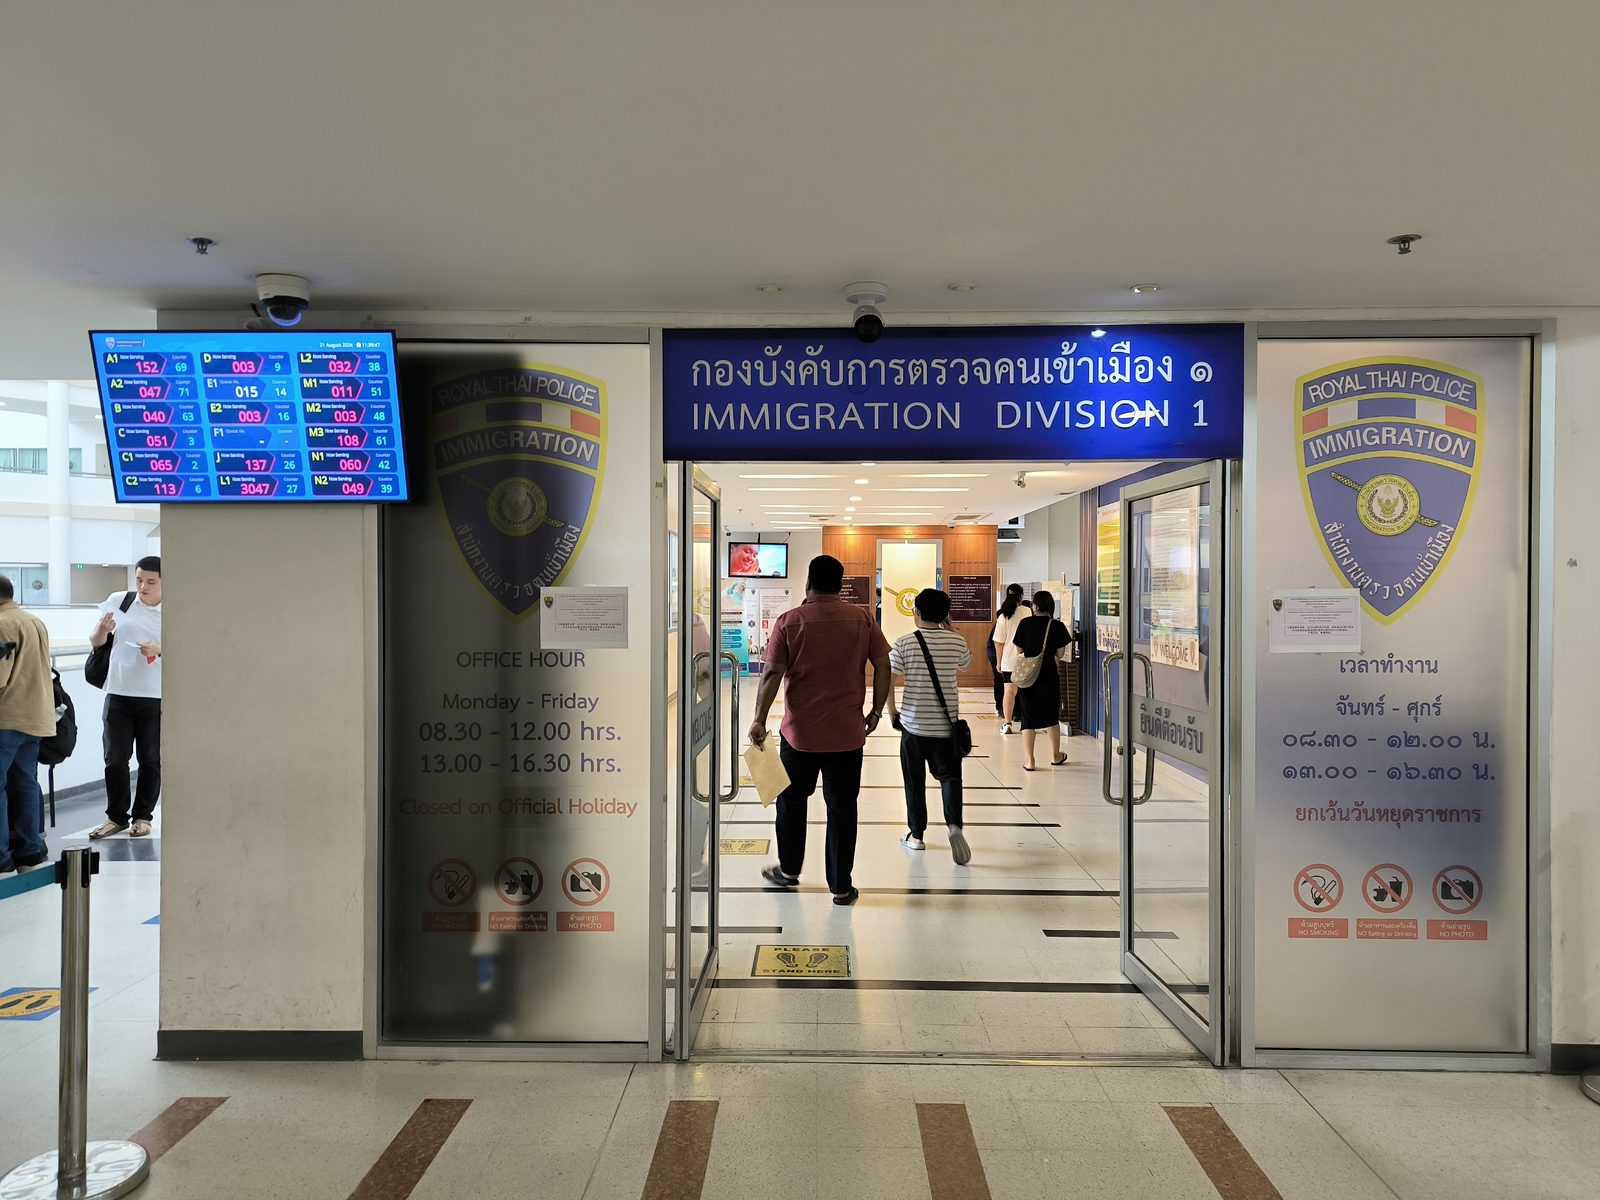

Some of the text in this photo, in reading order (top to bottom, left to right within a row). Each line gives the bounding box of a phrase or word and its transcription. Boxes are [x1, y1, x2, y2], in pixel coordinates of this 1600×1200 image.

[106, 354, 118, 363] A1
[204, 354, 211, 363] D
[300, 354, 312, 362] L2
[136, 362, 158, 373] 152
[175, 363, 187, 372] 69
[232, 361, 255, 373] 003
[275, 363, 280, 371] 9
[329, 361, 352, 373] 032
[369, 363, 380, 371] 38
[691, 340, 1173, 387] กองบังคับการตรวจคนเข้าเมือง
[111, 380, 123, 388] A2
[207, 379, 217, 388] E1
[304, 379, 317, 388] M1
[1308, 371, 1473, 403] ROYAL THAI POLICE
[139, 387, 161, 398] 047
[178, 388, 189, 396] 71
[235, 386, 258, 398] 015
[275, 388, 286, 396] 14
[332, 386, 352, 397] 011
[371, 388, 382, 396] 51
[439, 376, 597, 407] ROYAL THAI POLICE
[114, 405, 121, 413] B
[210, 404, 222, 413] E2
[306, 403, 321, 412] M2
[143, 411, 165, 422] 040
[182, 413, 194, 421] 63
[239, 411, 261, 422] 003
[278, 413, 290, 421] 16
[334, 411, 356, 422] 003
[374, 412, 385, 420] 48
[692, 399, 1209, 430] IMMIGRATION DIVISION 1
[118, 428, 125, 437] C
[214, 428, 224, 437] F1
[309, 428, 324, 437] M3
[147, 436, 168, 446] 051
[189, 437, 194, 445] 3
[337, 436, 359, 446] 108
[376, 437, 386, 445] 61
[439, 430, 595, 462] IMMIGRATION
[1309, 427, 1471, 459] IMMIGRATION
[122, 453, 133, 461] C1
[217, 452, 220, 463] J
[312, 452, 324, 461] N1
[151, 460, 172, 471] 065
[192, 462, 198, 470] 2
[246, 460, 266, 470] 137
[284, 461, 295, 469] 26
[340, 460, 362, 470] 060
[379, 461, 390, 469] 42
[126, 477, 138, 485] C2
[220, 476, 230, 485] L1
[315, 476, 328, 485] N2
[154, 484, 176, 494] 113
[196, 485, 201, 493] 6
[241, 484, 270, 494] 3047
[287, 485, 298, 493] 27
[342, 483, 364, 494] 049
[381, 485, 392, 493] 39
[1362, 513, 1415, 533] IMMIGRATION BUREAU
[1159, 644, 1189, 662] WELCOME
[456, 652, 586, 668] OFFICE HOUR
[1340, 653, 1438, 674] เวลาทำงาน
[443, 693, 520, 712] Monday
[541, 693, 600, 712] Friday
[1336, 694, 1386, 716] จันทร์
[1407, 694, 1442, 722] ศุกร์
[419, 721, 482, 742] 08.30
[510, 721, 571, 741] 12.00
[580, 720, 622, 741] hrs.
[1140, 703, 1204, 754] ยินดีต้อนรับ
[1473, 730, 1495, 749] น.
[420, 753, 482, 773] 13.00
[510, 753, 571, 773] 16.30
[580, 752, 622, 773] hrs.
[1473, 762, 1495, 781] น.
[400, 798, 638, 818] Closed on Official Holiday
[1295, 800, 1482, 828] ยกเว้นวันหยุดราชการ
[500, 923, 516, 931] Eating
[1309, 929, 1340, 937] SMOKING
